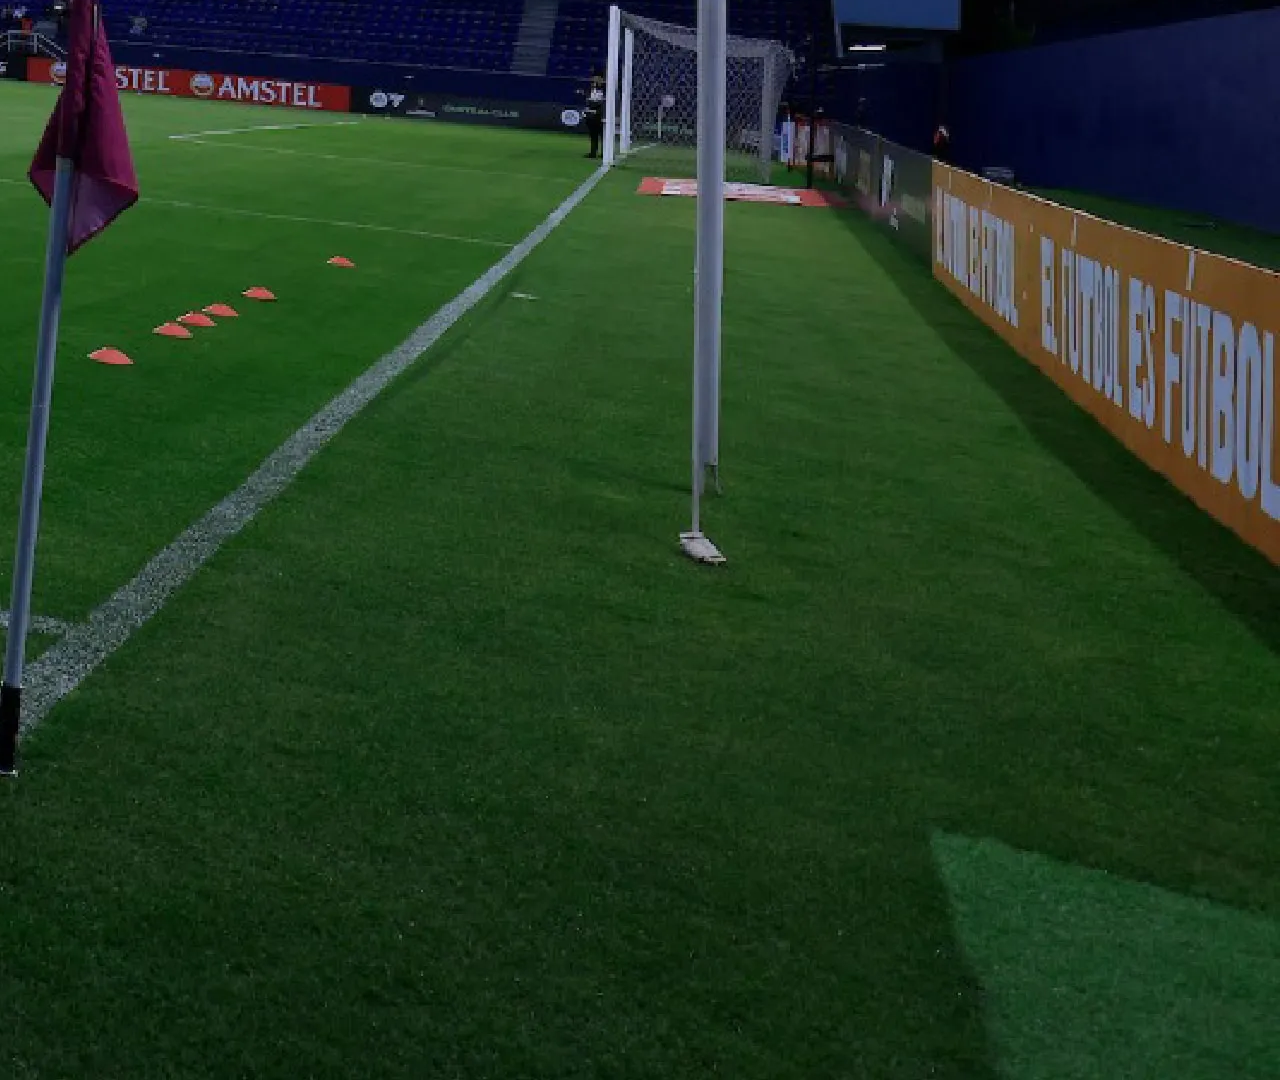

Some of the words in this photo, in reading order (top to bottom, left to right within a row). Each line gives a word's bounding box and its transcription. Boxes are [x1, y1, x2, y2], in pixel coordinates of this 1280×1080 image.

[115, 66, 170, 92] STEL
[218, 77, 322, 108] AMSTEL
[1129, 275, 1156, 429] ES
